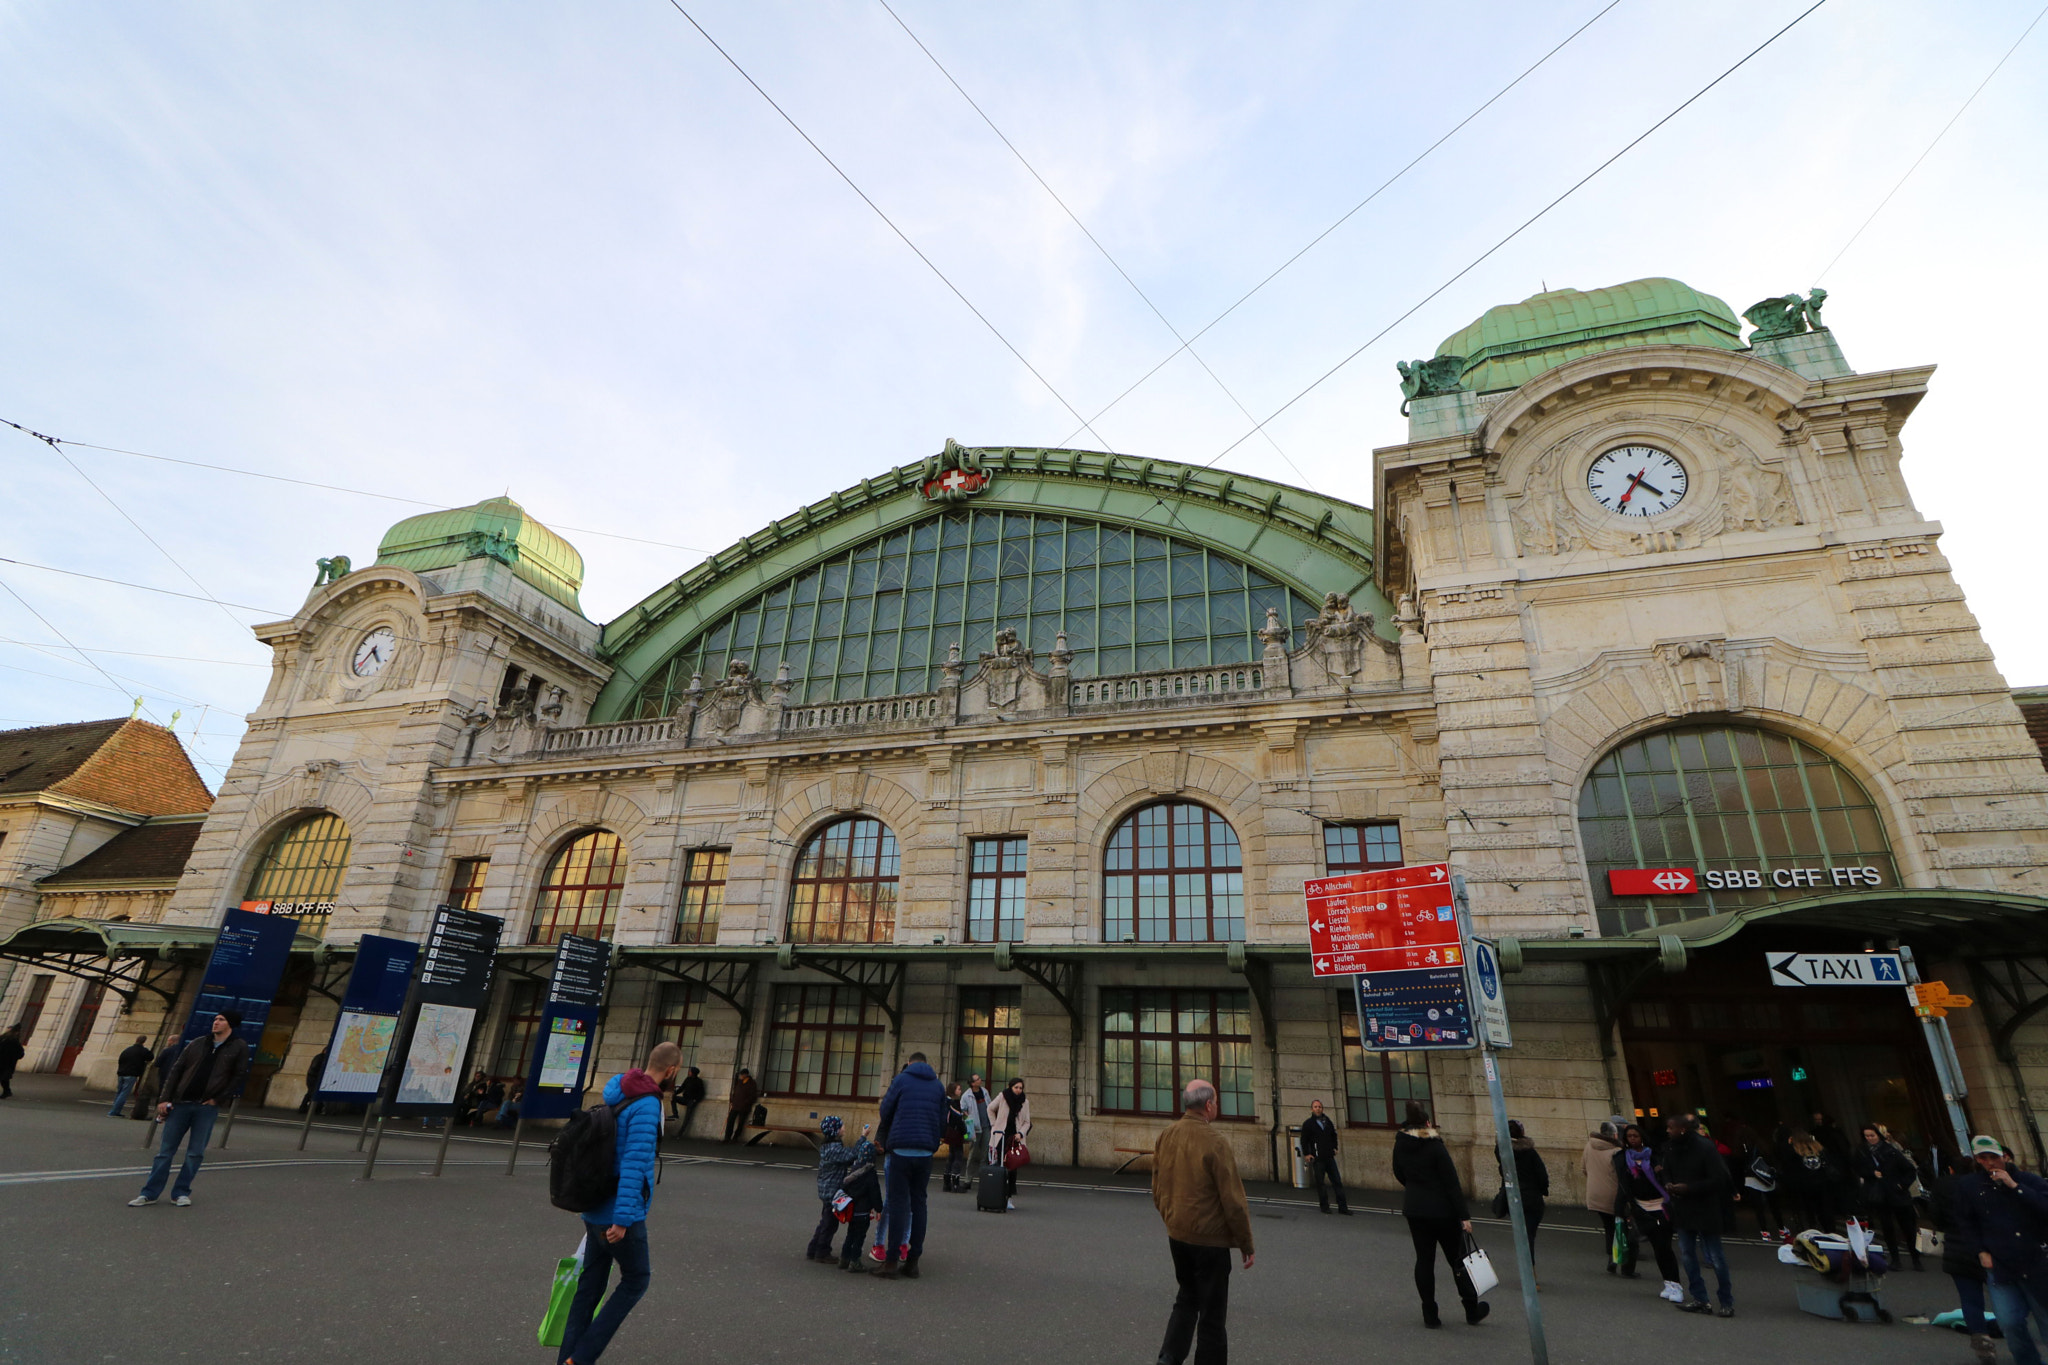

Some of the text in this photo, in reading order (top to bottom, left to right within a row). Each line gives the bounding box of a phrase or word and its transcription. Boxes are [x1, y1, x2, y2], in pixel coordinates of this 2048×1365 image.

[1704, 866, 1882, 888] SBB CFF FFS
[1324, 881, 1352, 890] Allschwil
[1326, 898, 1347, 906] Laufen
[272, 902, 335, 914] SBB CFF FFS
[1328, 916, 1349, 924] Liestal
[1438, 911, 1450, 921] 23
[1330, 925, 1350, 933] Riehen
[1331, 931, 1375, 942] Münchenstein
[1445, 951, 1454, 963] 3
[1804, 959, 1863, 979] TAXI
